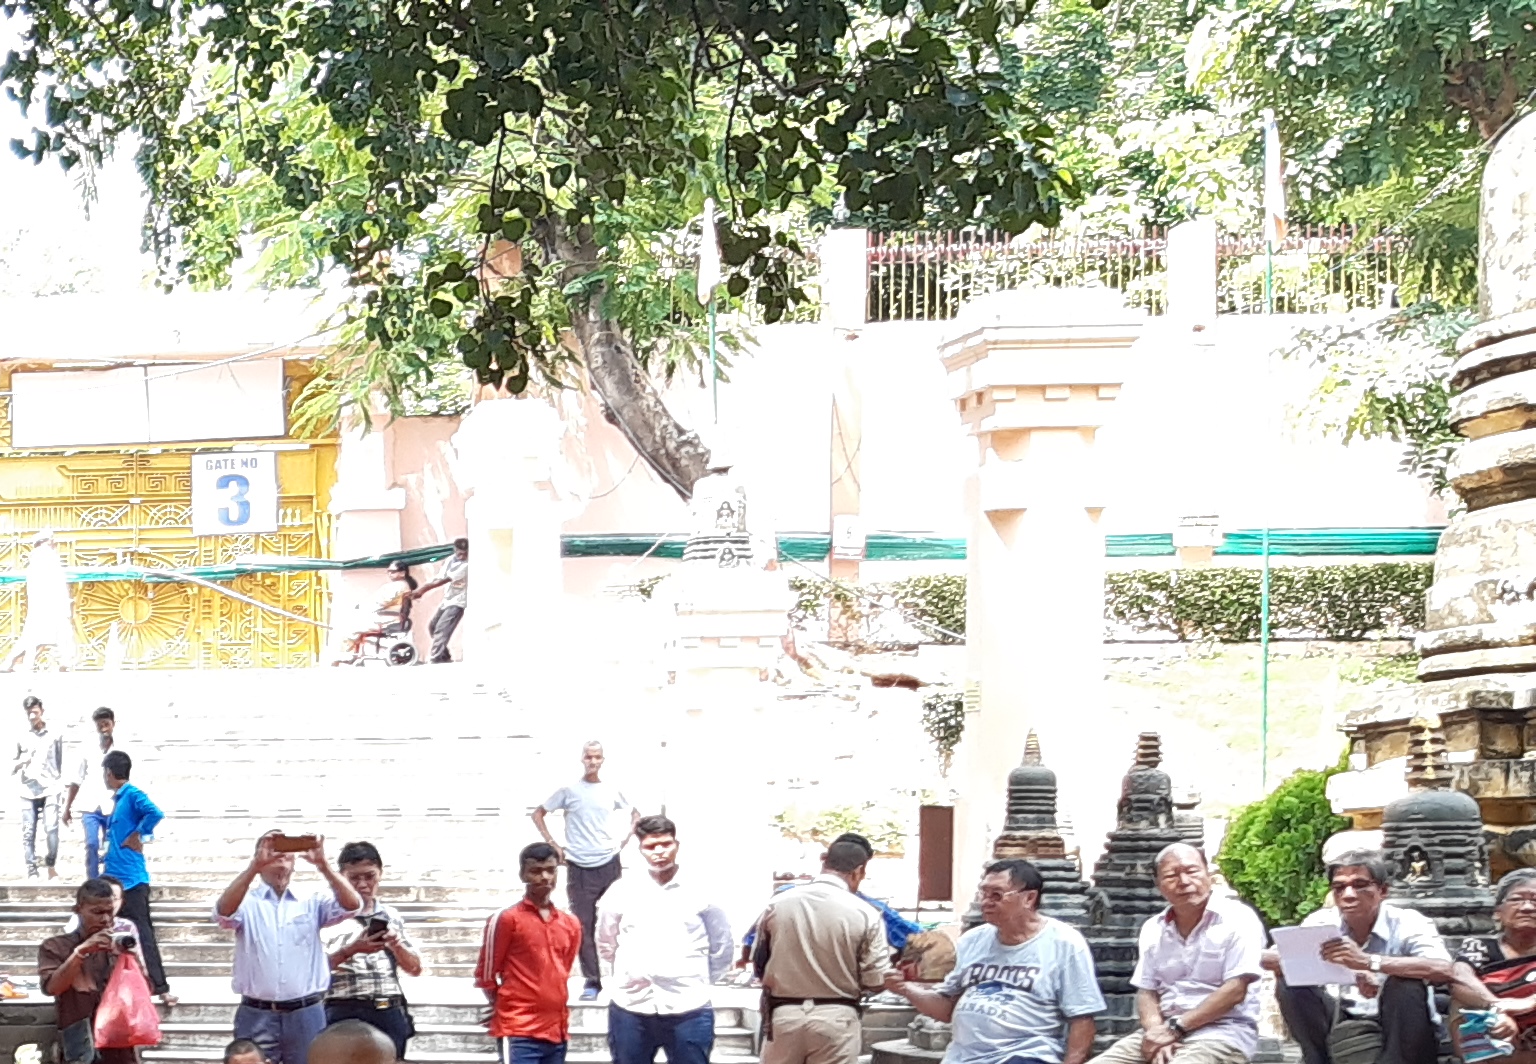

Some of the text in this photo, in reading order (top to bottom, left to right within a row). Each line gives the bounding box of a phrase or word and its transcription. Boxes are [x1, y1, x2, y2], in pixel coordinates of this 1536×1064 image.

[206, 457, 258, 470] GATE NO
[216, 474, 250, 526] 3
